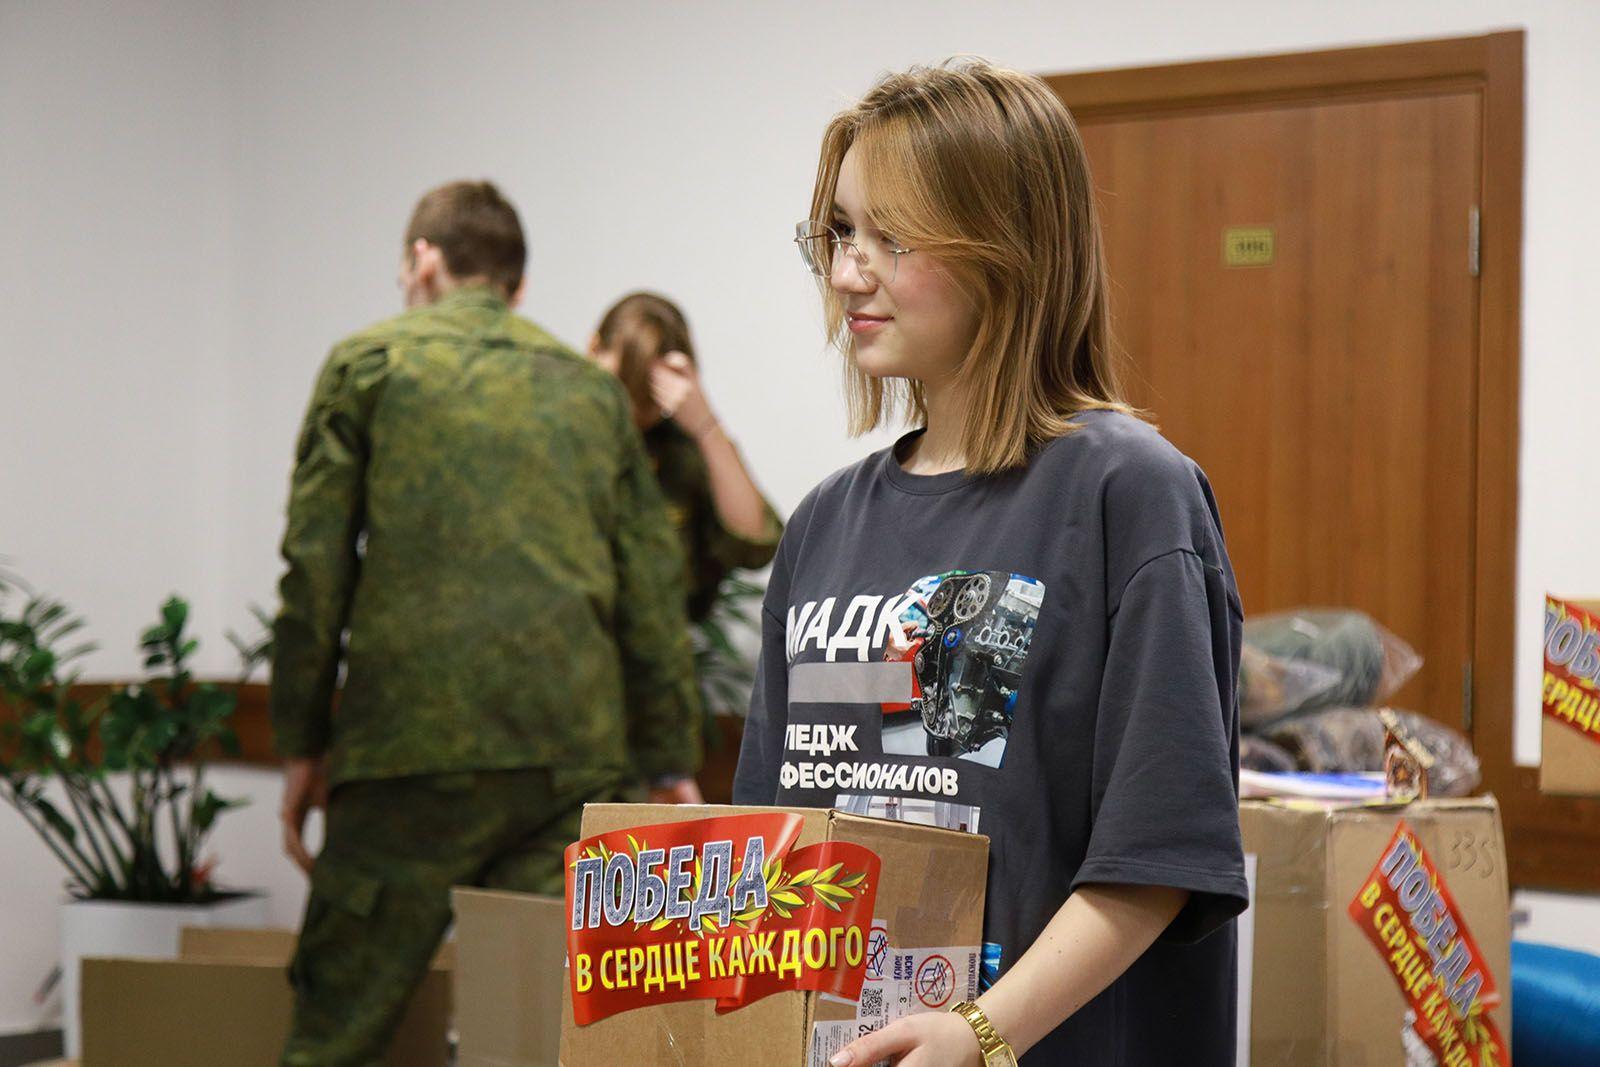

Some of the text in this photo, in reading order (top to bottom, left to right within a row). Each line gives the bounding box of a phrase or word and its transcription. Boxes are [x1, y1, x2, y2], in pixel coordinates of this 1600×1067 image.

[780, 761, 959, 796] ФЕССИОНАЛОВ
[571, 836, 768, 931] ПОБЕДА
[1380, 837, 1484, 1019] ПОБЕДА
[576, 925, 863, 993] В СЕРДЦЕ КАЖДОГО
[1360, 879, 1382, 909] В
[1373, 902, 1433, 999] СЕРДЦЕ
